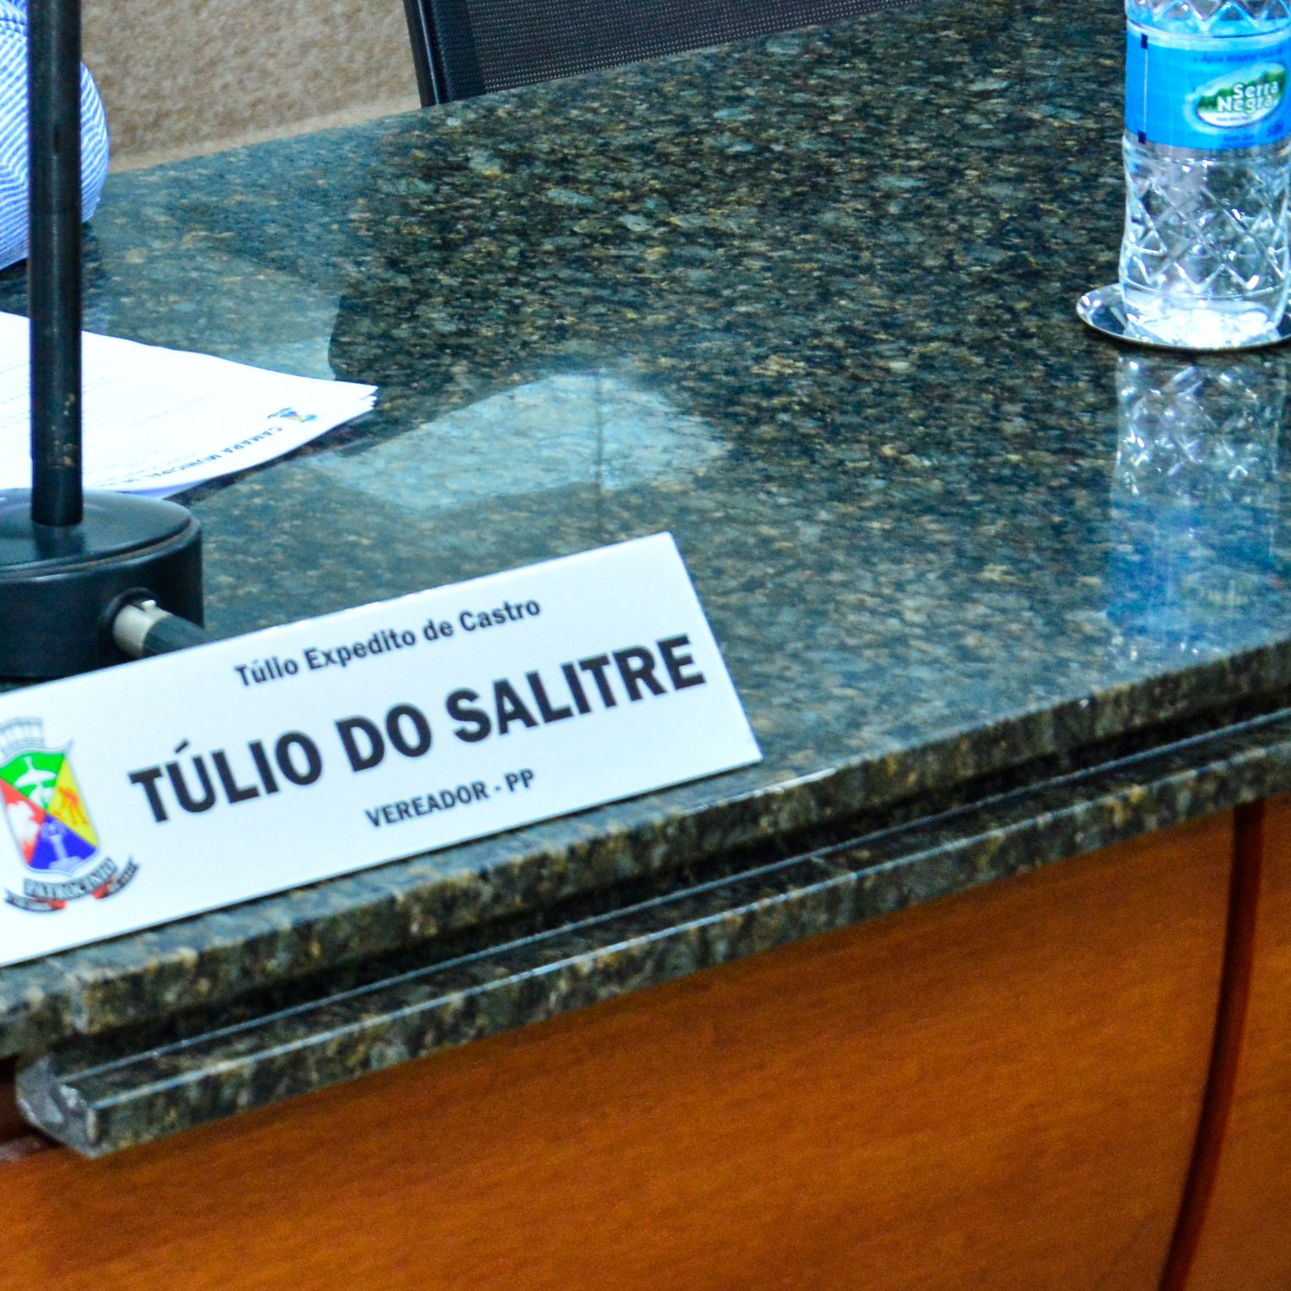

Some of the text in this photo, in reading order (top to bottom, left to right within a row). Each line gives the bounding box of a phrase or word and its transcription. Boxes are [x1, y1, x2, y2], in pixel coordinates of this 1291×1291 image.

[1216, 96, 1273, 115] Negra
[1232, 81, 1279, 100] Serra
[235, 600, 540, 686] Túlio Expedito de Castro
[127, 633, 707, 824] TÚLIO DO SALITRE
[365, 781, 489, 827] VEREADOR
[505, 769, 535, 793] PP
